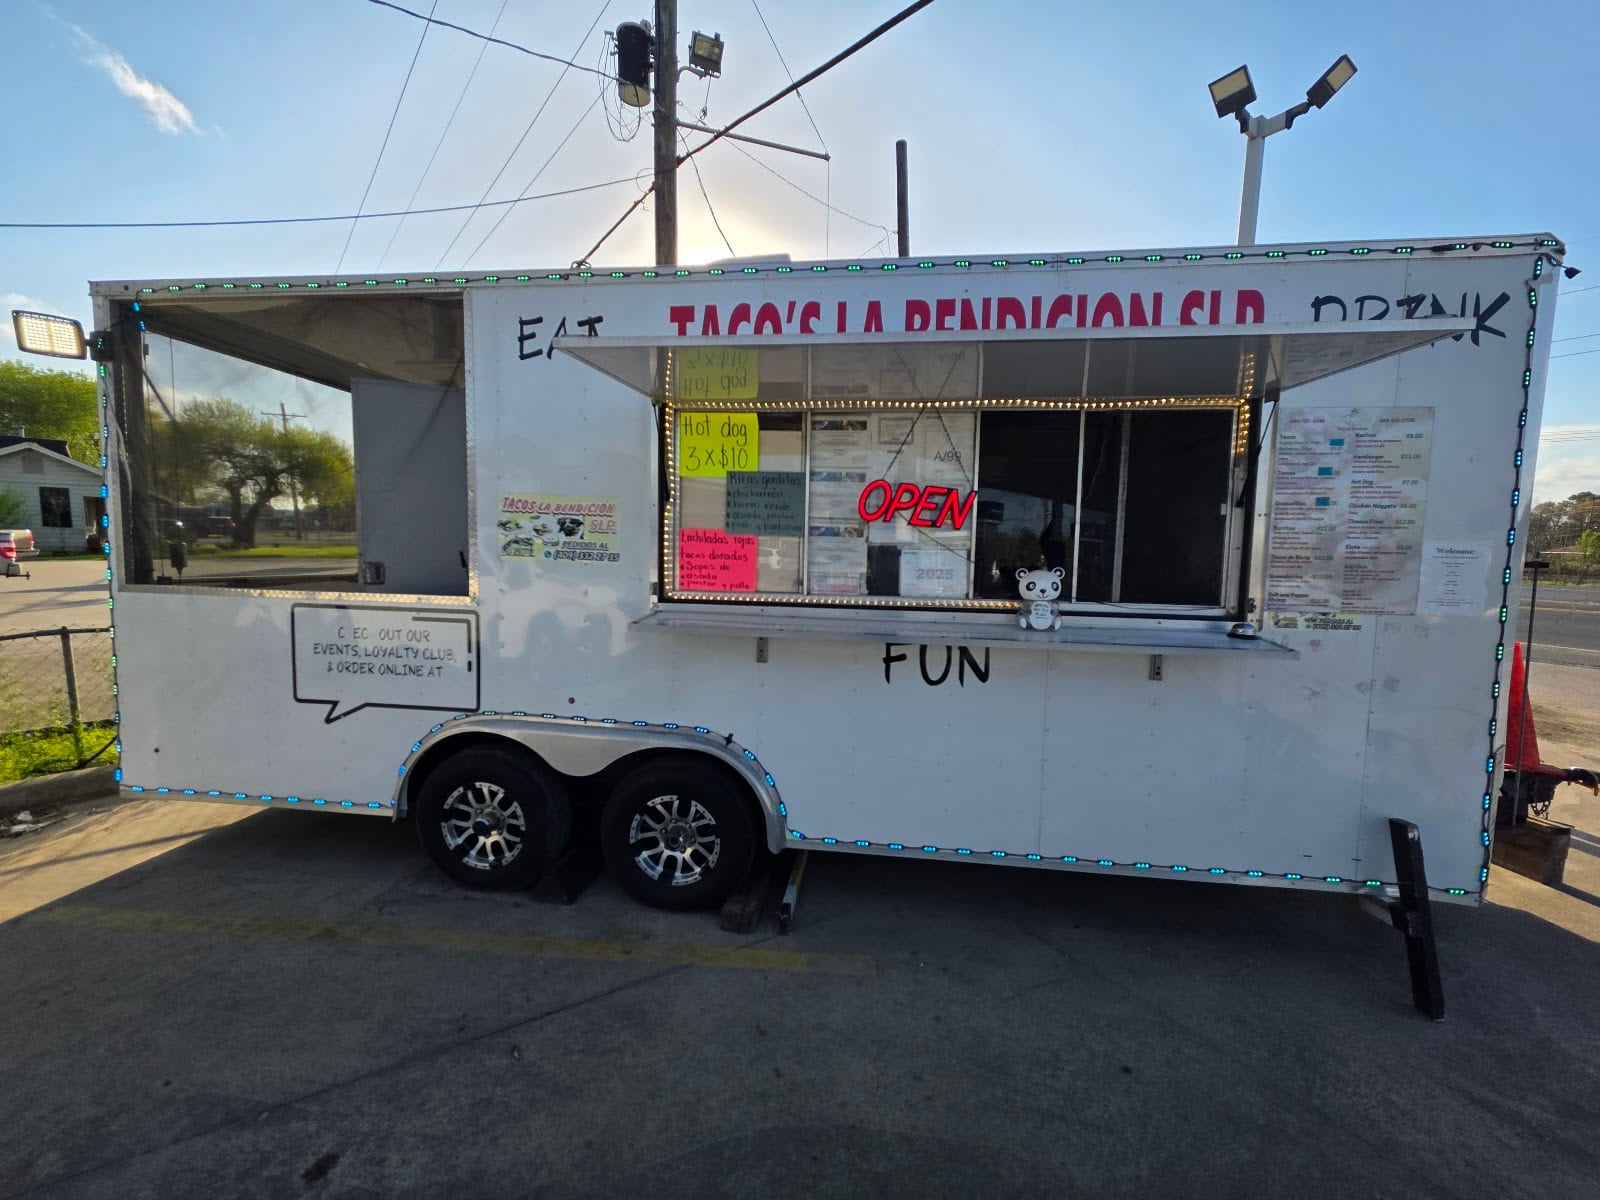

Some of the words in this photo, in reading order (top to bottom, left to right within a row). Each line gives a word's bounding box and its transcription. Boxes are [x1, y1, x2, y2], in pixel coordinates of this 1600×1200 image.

[680, 413, 710, 436] Hot
[721, 415, 748, 447] dog
[858, 479, 978, 530] OPEN
[916, 568, 954, 580] 2025
[379, 629, 402, 642] OUT
[406, 630, 431, 643] OUR
[313, 643, 361, 659] EVENTS,
[364, 648, 418, 660] LOYALTY
[336, 662, 375, 675] ORDER
[378, 663, 424, 677] ONLINE
[427, 666, 444, 678] AT
[883, 643, 990, 687] FUN
